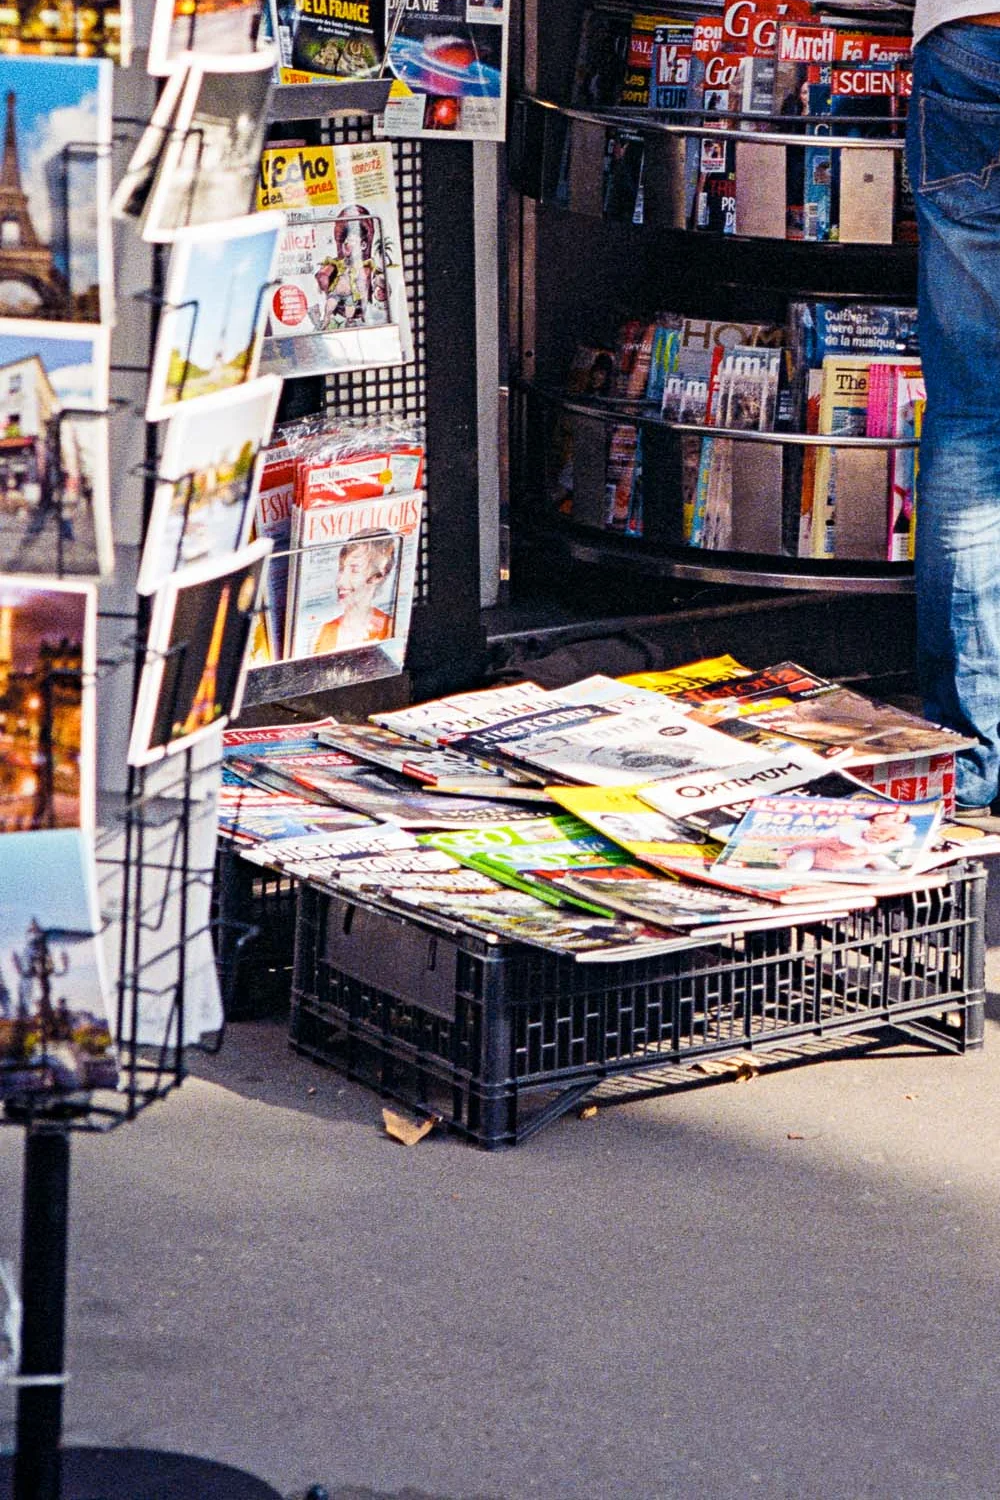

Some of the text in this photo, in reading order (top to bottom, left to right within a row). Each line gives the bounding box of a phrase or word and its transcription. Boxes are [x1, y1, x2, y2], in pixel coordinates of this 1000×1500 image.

[329, 0, 370, 24] FRANCE
[422, 0, 439, 13] VIE
[780, 27, 835, 62] MATCH
[840, 335, 850, 346] la
[855, 324, 889, 336] amour
[836, 373, 867, 391] The
[308, 498, 420, 541] PSYCHOLOGIES
[675, 762, 803, 799] OPTIMUM
